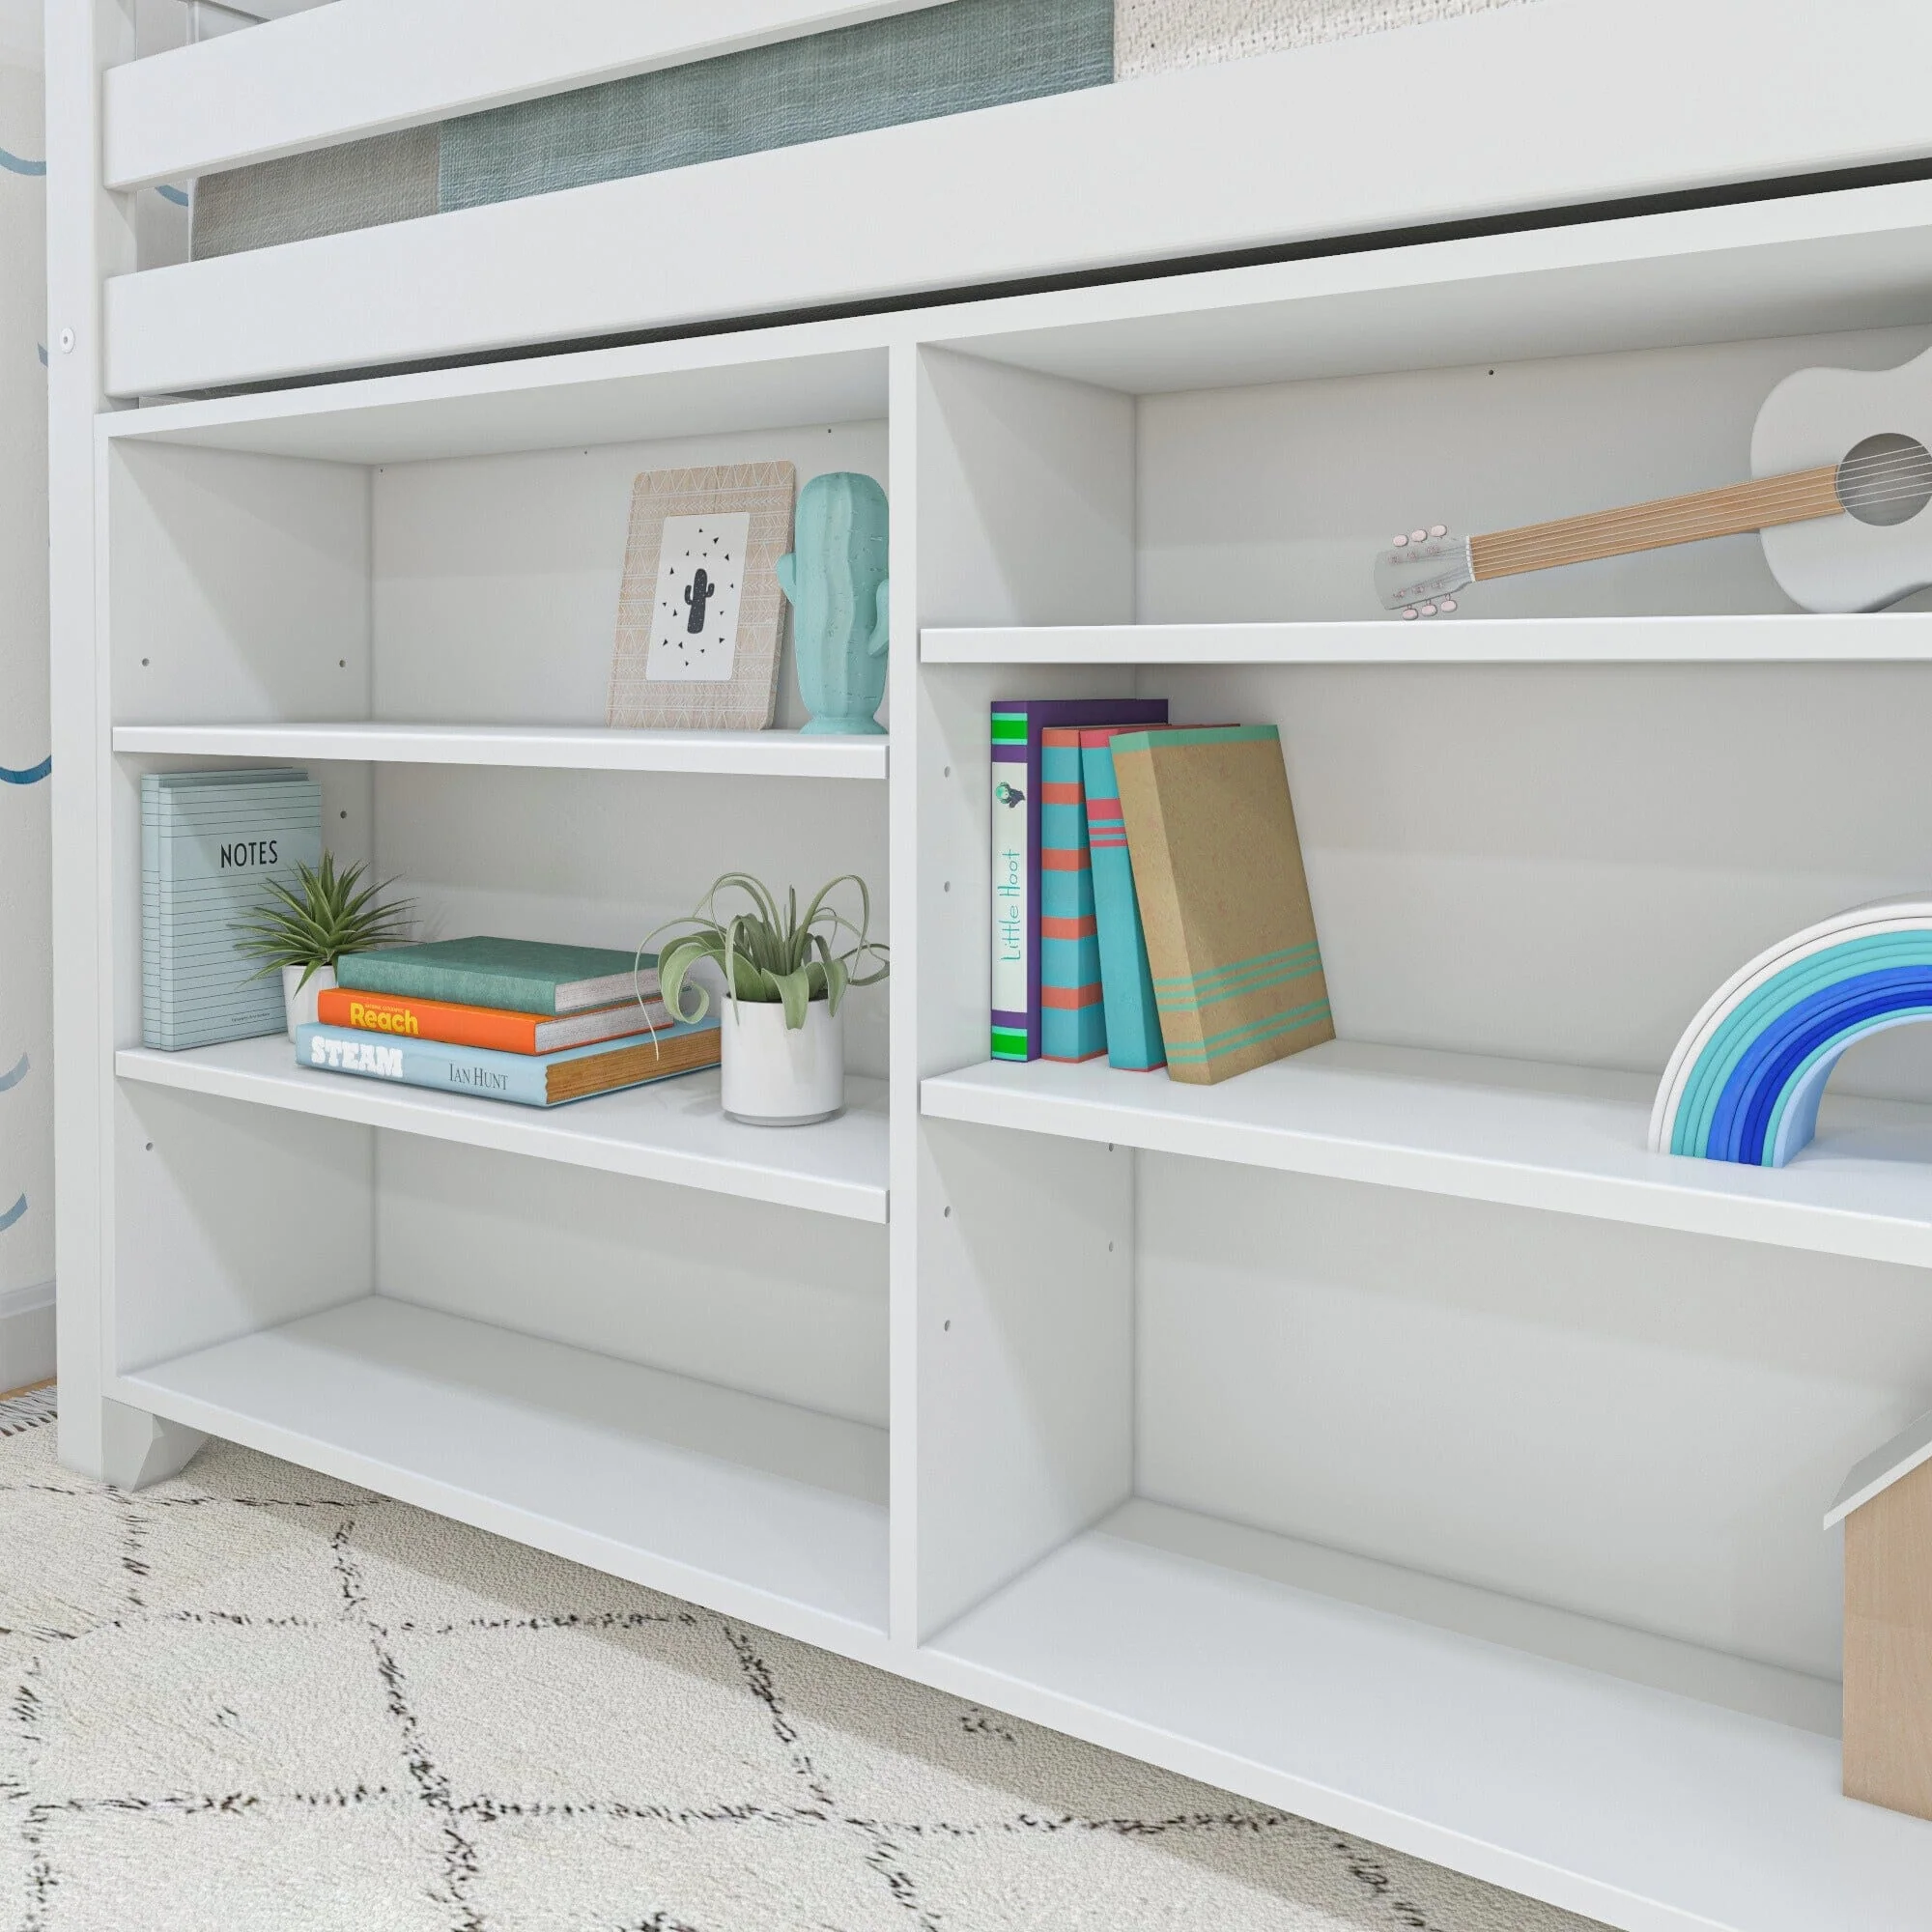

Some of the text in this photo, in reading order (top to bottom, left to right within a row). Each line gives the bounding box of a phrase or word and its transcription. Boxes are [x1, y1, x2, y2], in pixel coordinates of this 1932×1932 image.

[220, 839, 278, 868] NOTES
[997, 849, 1021, 960] Little Hoot
[350, 1002, 419, 1035] Reach
[311, 1035, 404, 1078] STEAM
